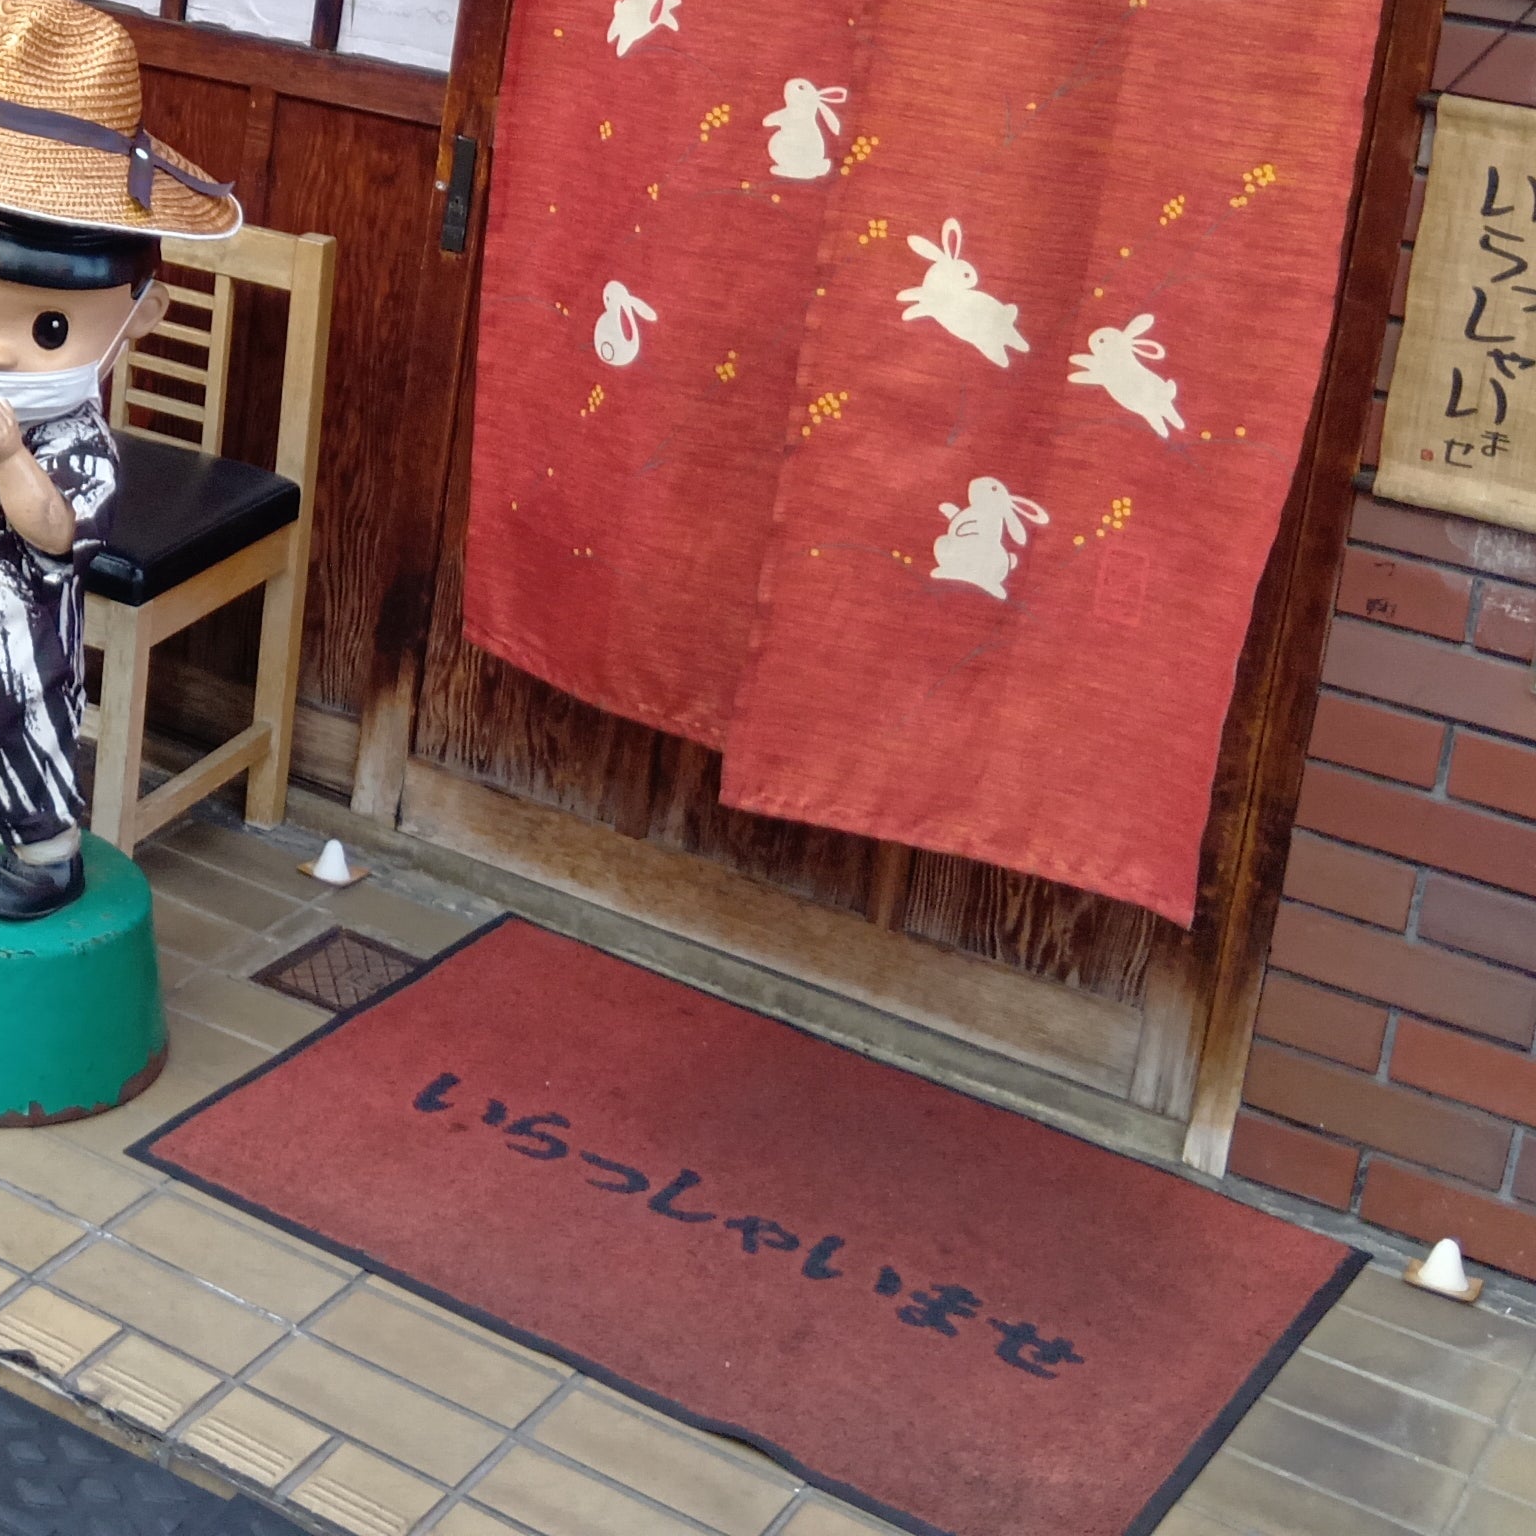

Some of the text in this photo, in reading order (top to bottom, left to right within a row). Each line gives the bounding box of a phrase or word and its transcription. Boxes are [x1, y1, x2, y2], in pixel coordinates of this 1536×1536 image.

[410, 1072, 1085, 1379] いらっしゃいませ
